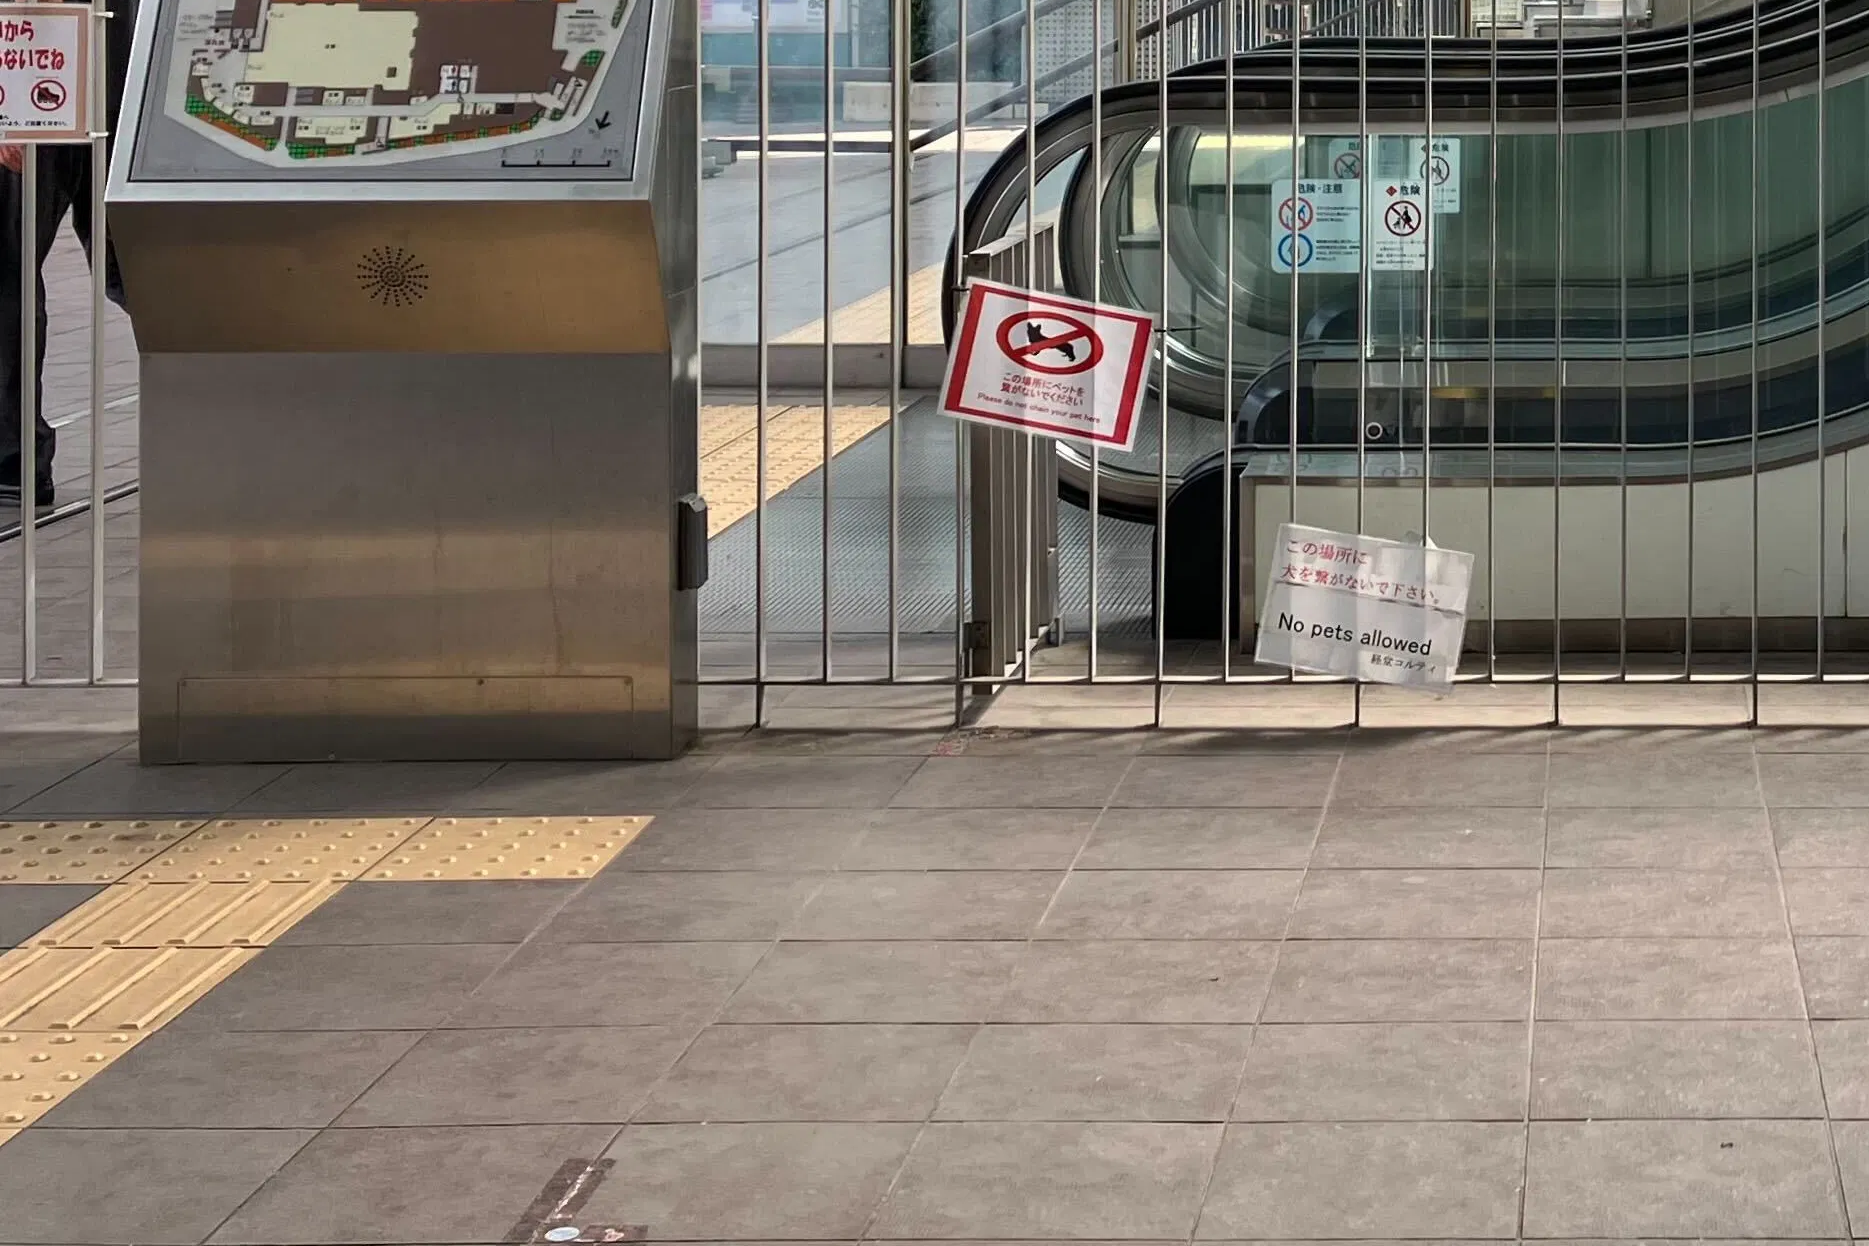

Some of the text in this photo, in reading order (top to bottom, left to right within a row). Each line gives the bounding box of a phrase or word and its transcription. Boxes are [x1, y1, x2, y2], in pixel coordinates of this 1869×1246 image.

[0, 20, 34, 43] から
[0, 48, 65, 71] ないでね
[1400, 185, 1422, 197] 危険
[1000, 382, 1084, 407] 繋がないでください
[1003, 372, 1085, 397] この場所にペットを
[977, 392, 1101, 424] Please do not chain your pet here
[1286, 539, 1369, 566] この場所に
[1281, 562, 1440, 605] 犬を繋がないで下さい。
[1278, 611, 1433, 656] No pets allowed
[1370, 653, 1437, 673] 経堂コルティ
